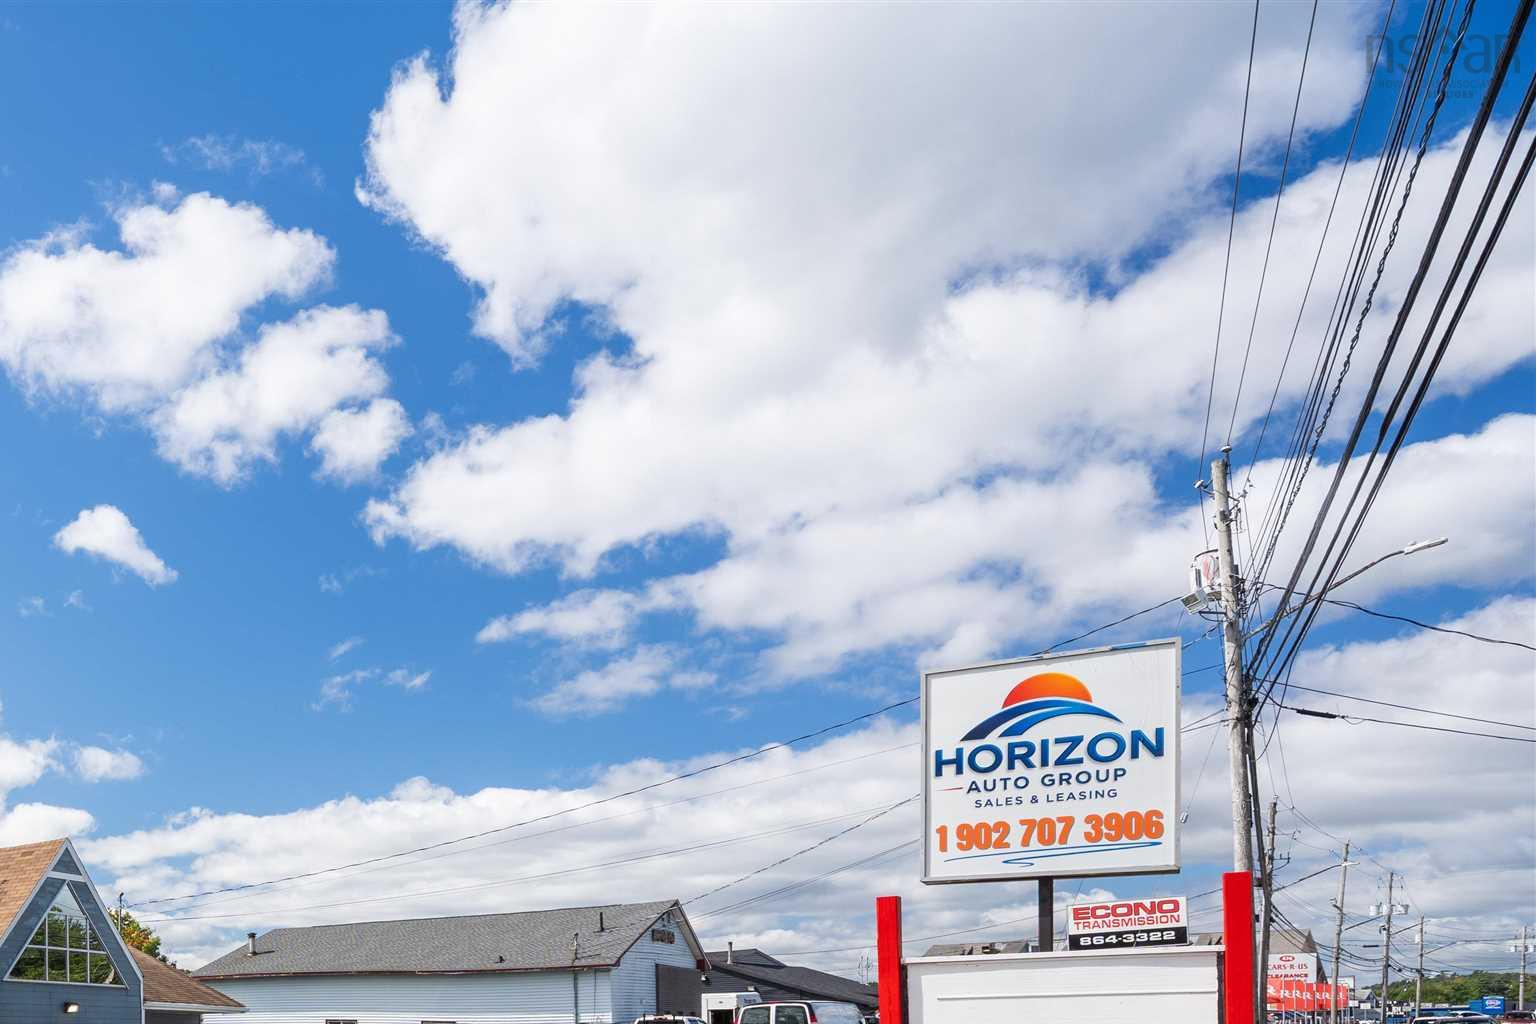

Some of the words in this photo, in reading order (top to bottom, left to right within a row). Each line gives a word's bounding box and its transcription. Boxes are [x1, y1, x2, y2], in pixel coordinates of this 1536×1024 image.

[934, 727, 1165, 777] HORIZON
[966, 776, 1030, 794] AUTO
[1040, 768, 1127, 787] GROUP
[974, 796, 1024, 809] SALES
[1030, 795, 1039, 804] &
[1046, 789, 1119, 803] LEASING
[935, 825, 948, 852] 1
[955, 820, 1011, 851] 902
[1019, 815, 1075, 848] 707
[1083, 809, 1165, 843] 3906
[1072, 899, 1180, 921] ECONO
[1074, 914, 1181, 931] TRANSMISSION
[1079, 930, 1176, 946] 864-3322
